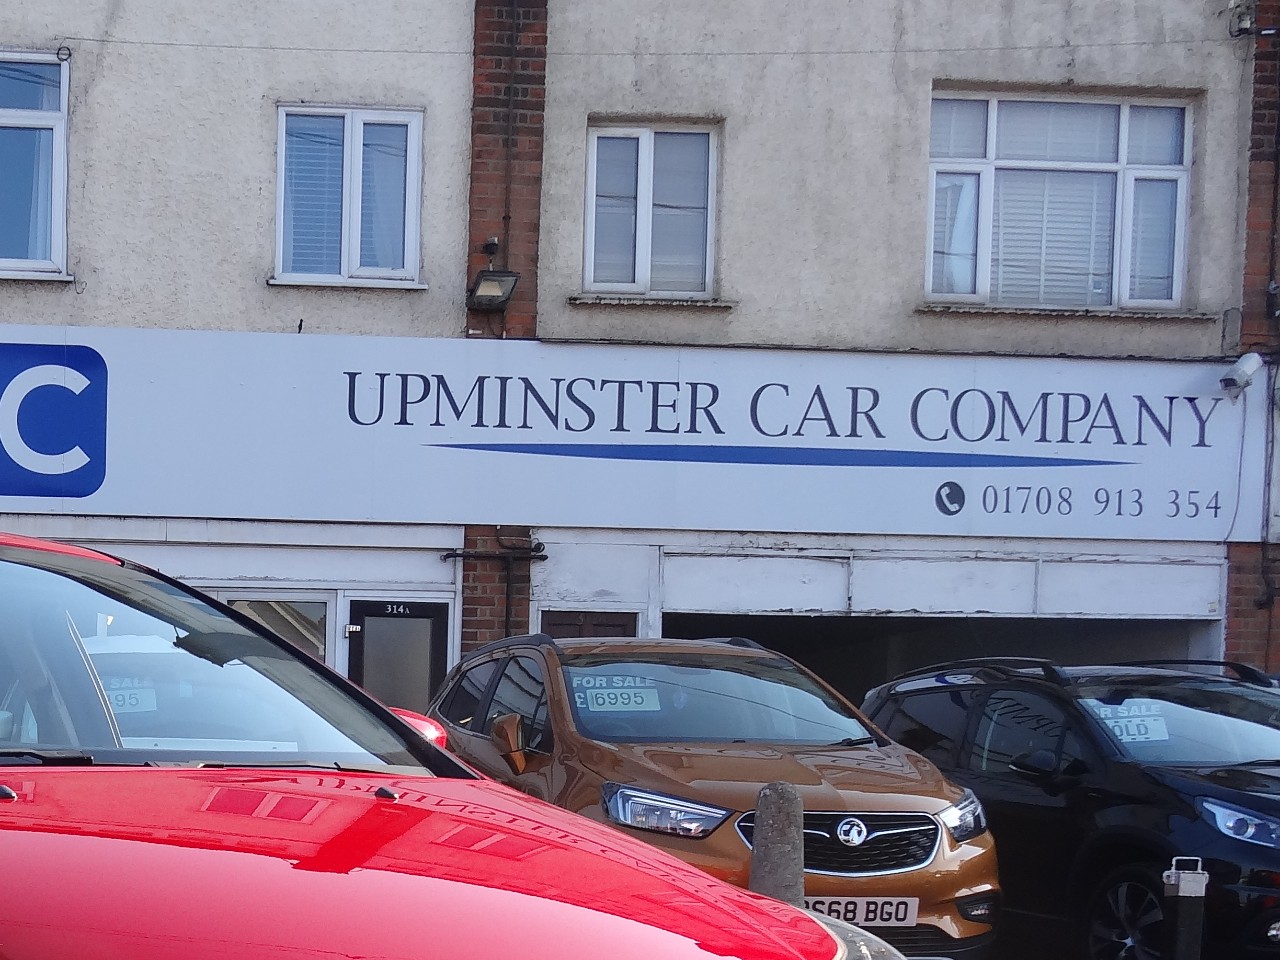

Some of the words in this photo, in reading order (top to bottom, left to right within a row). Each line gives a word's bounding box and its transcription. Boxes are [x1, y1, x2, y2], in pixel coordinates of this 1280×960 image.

[342, 371, 727, 435] UPMINSTER
[749, 382, 886, 439] CAR
[910, 387, 1224, 448] COMPANY
[981, 484, 1073, 516] 01708
[1093, 487, 1144, 517] 913
[1165, 488, 1223, 519] 354
[572, 676, 607, 688] FOR
[612, 676, 656, 687] SALE
[1117, 704, 1162, 717] SALE
[1111, 723, 1149, 738] OLD
[863, 900, 909, 922] BGO
